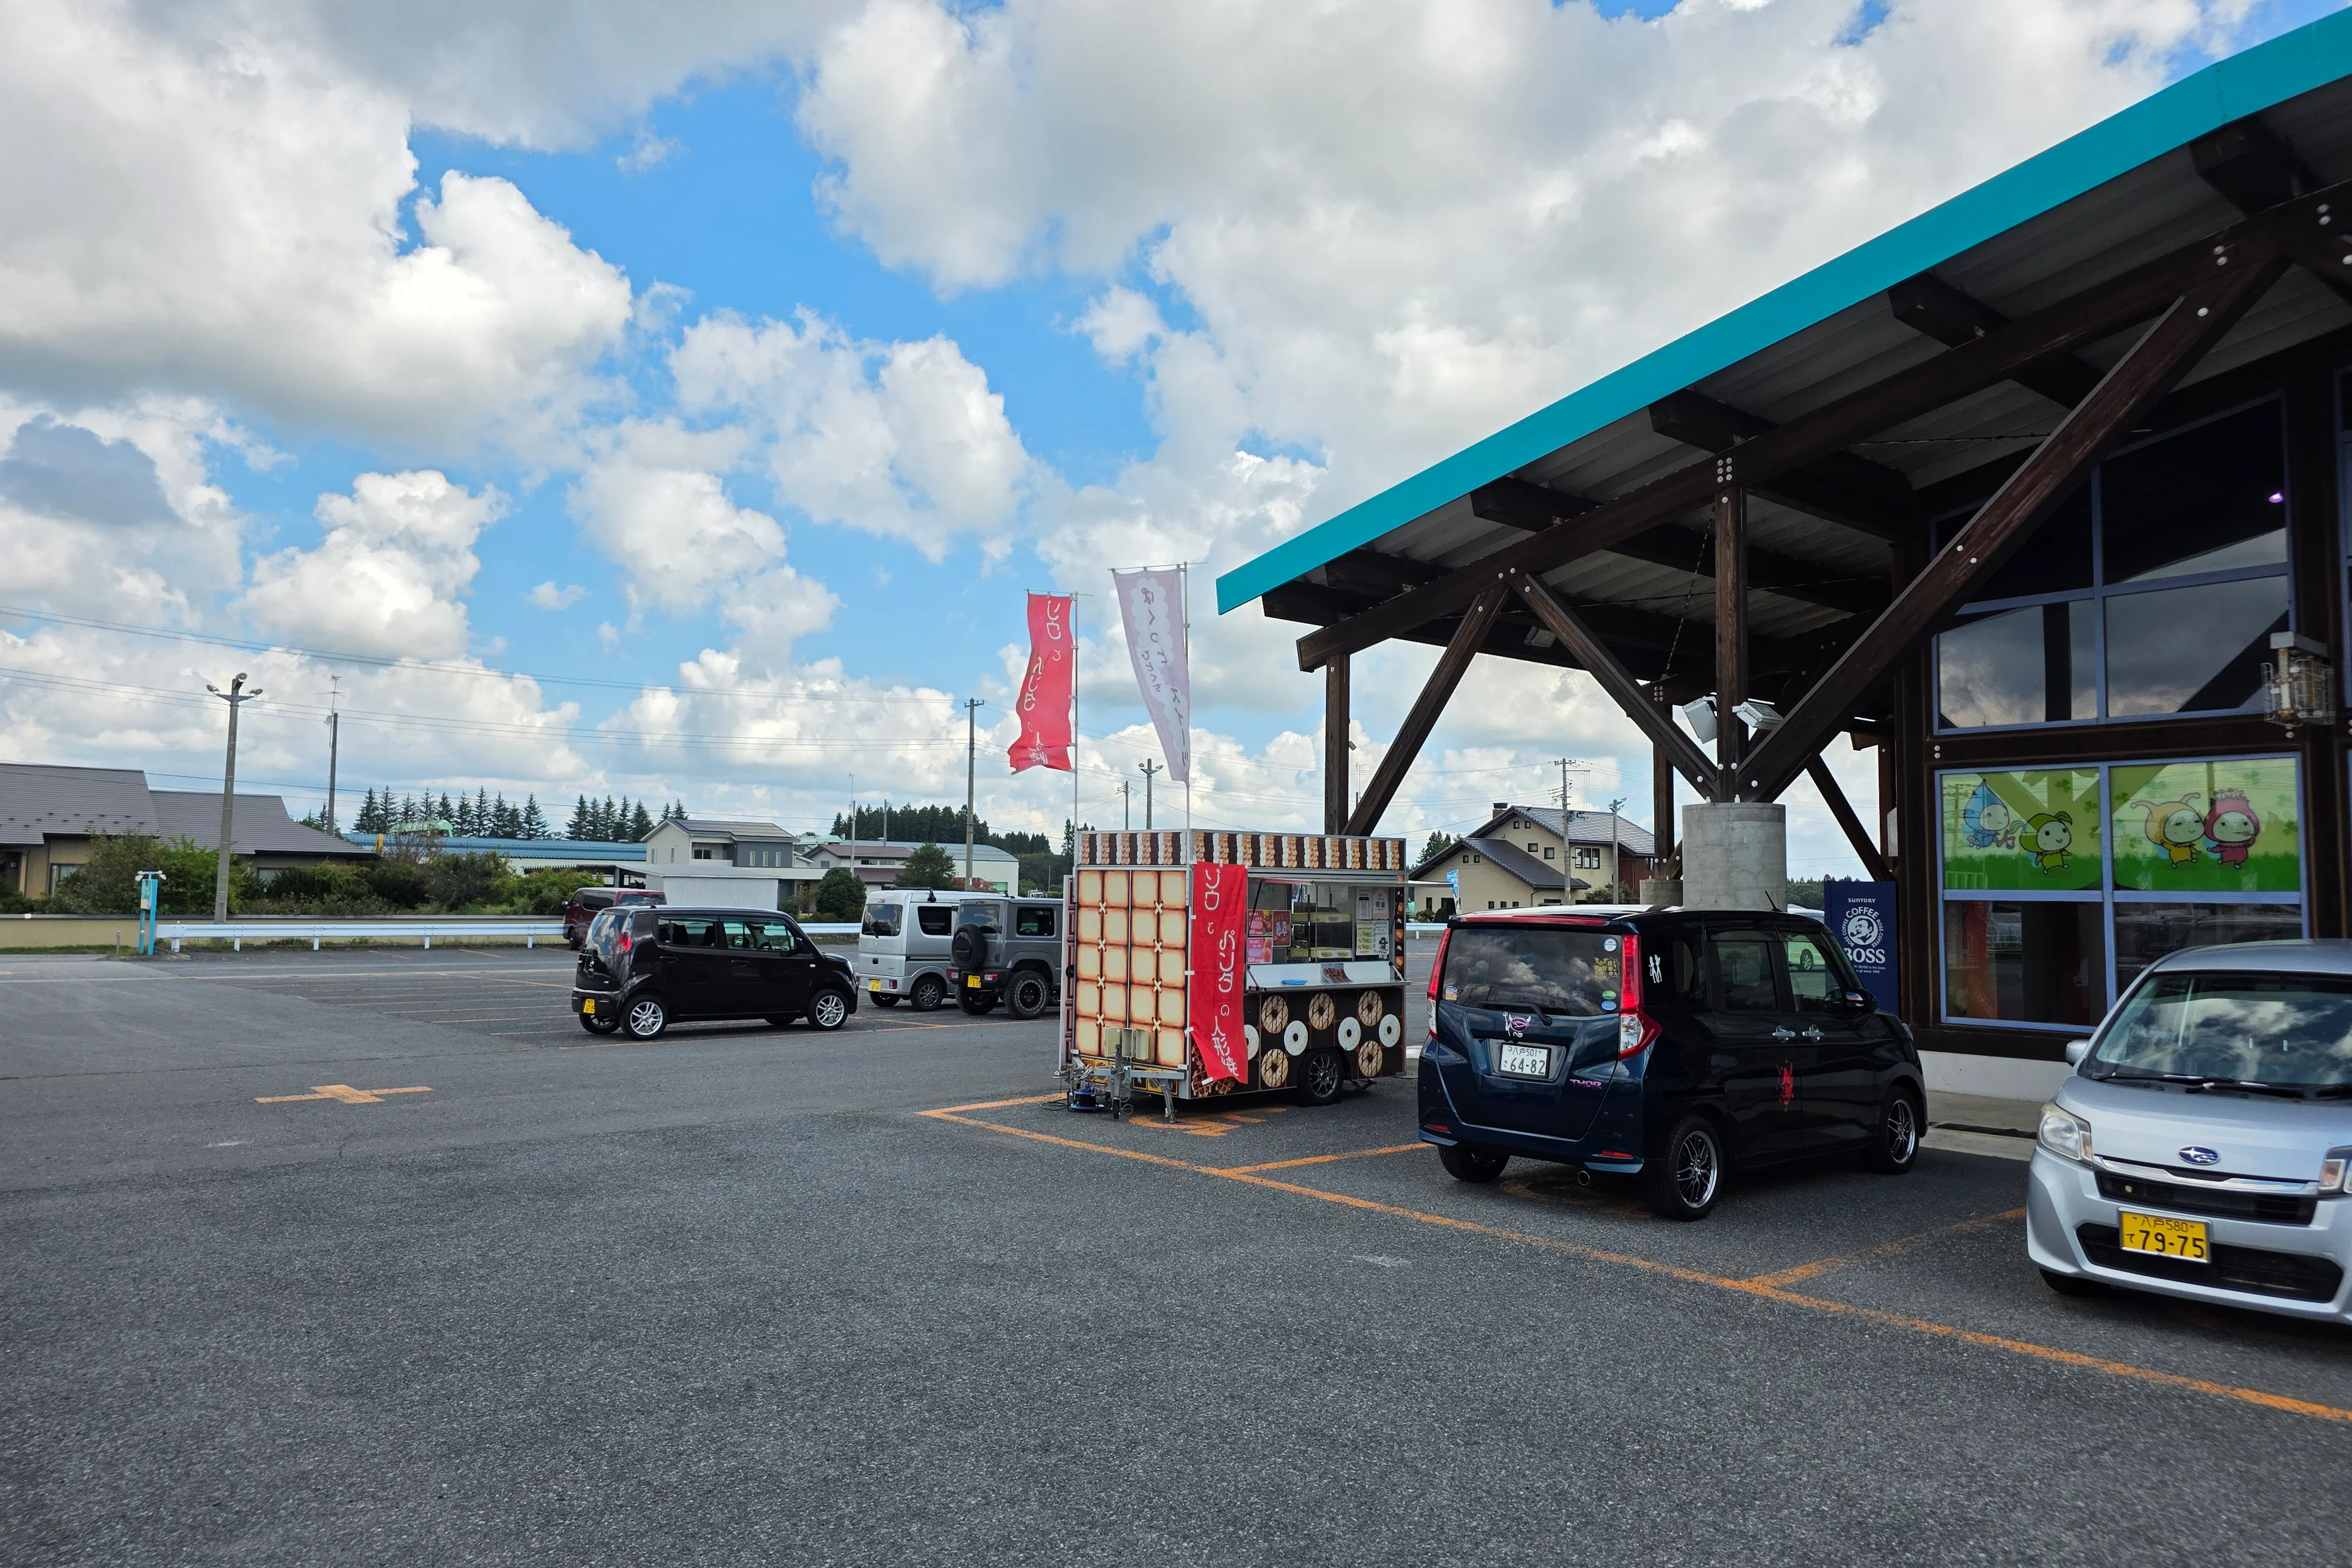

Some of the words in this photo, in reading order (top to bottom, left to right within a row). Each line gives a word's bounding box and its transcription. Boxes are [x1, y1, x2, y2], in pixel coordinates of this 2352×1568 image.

[1846, 907, 1879, 919] COFFEE
[1876, 919, 1884, 932] BOSS
[1844, 936, 1855, 947] BOSS
[1872, 933, 1883, 948] COFFEE
[1512, 1047, 1537, 1057] 八戸501
[1510, 1058, 1545, 1074] 64-82
[1569, 1079, 1602, 1089] THOR
[2141, 1216, 2189, 1232] 八戸580
[2125, 1233, 2135, 1243] て
[2139, 1229, 2204, 1258] 79-75
